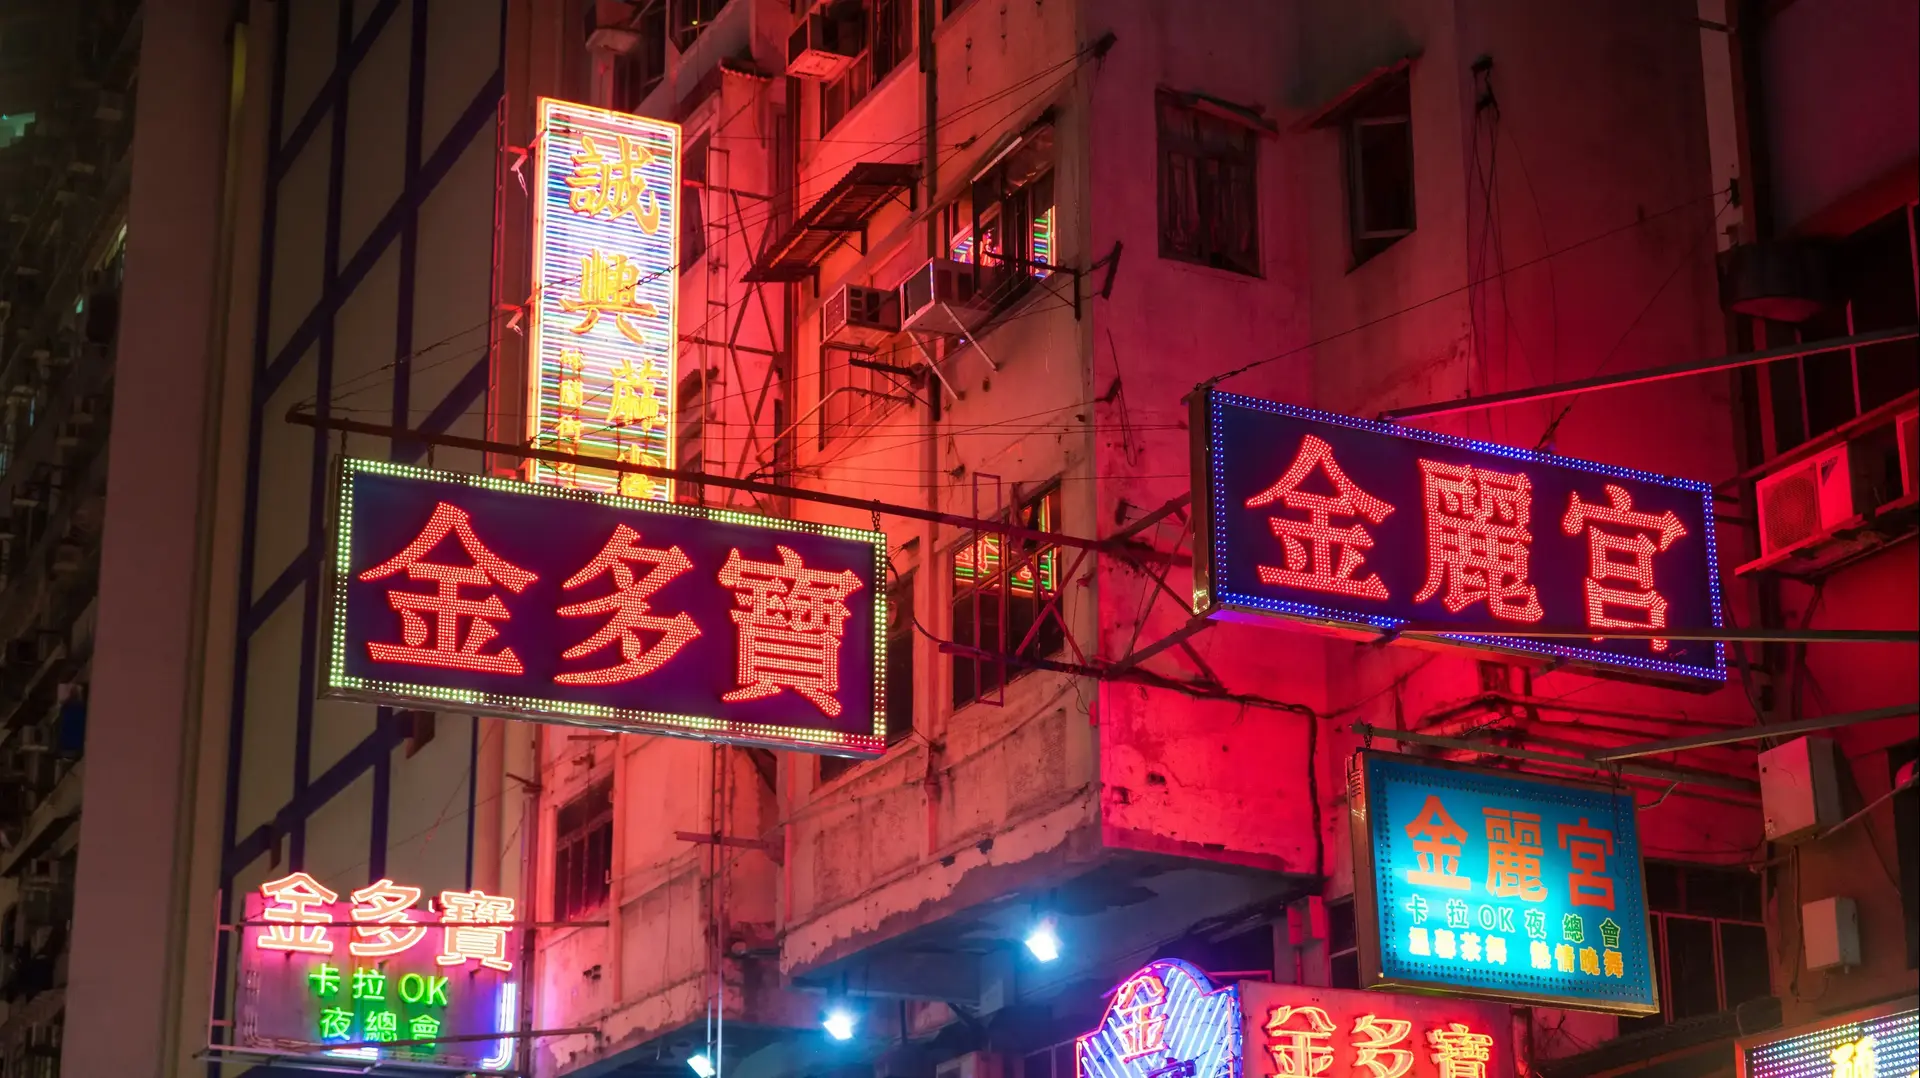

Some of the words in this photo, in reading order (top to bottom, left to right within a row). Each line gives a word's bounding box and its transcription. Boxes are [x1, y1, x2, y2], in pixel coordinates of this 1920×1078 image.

[1246, 433, 1687, 652] 金麗宮
[357, 501, 864, 718] 金多寶
[1404, 794, 1616, 911] 金麗宮
[257, 871, 515, 972] 金多寶
[308, 962, 450, 1006] 卡拉OK
[319, 1006, 441, 1048] 夜總會
[1111, 974, 1170, 1064] 金
[1266, 1005, 1495, 1078] 金多寶
